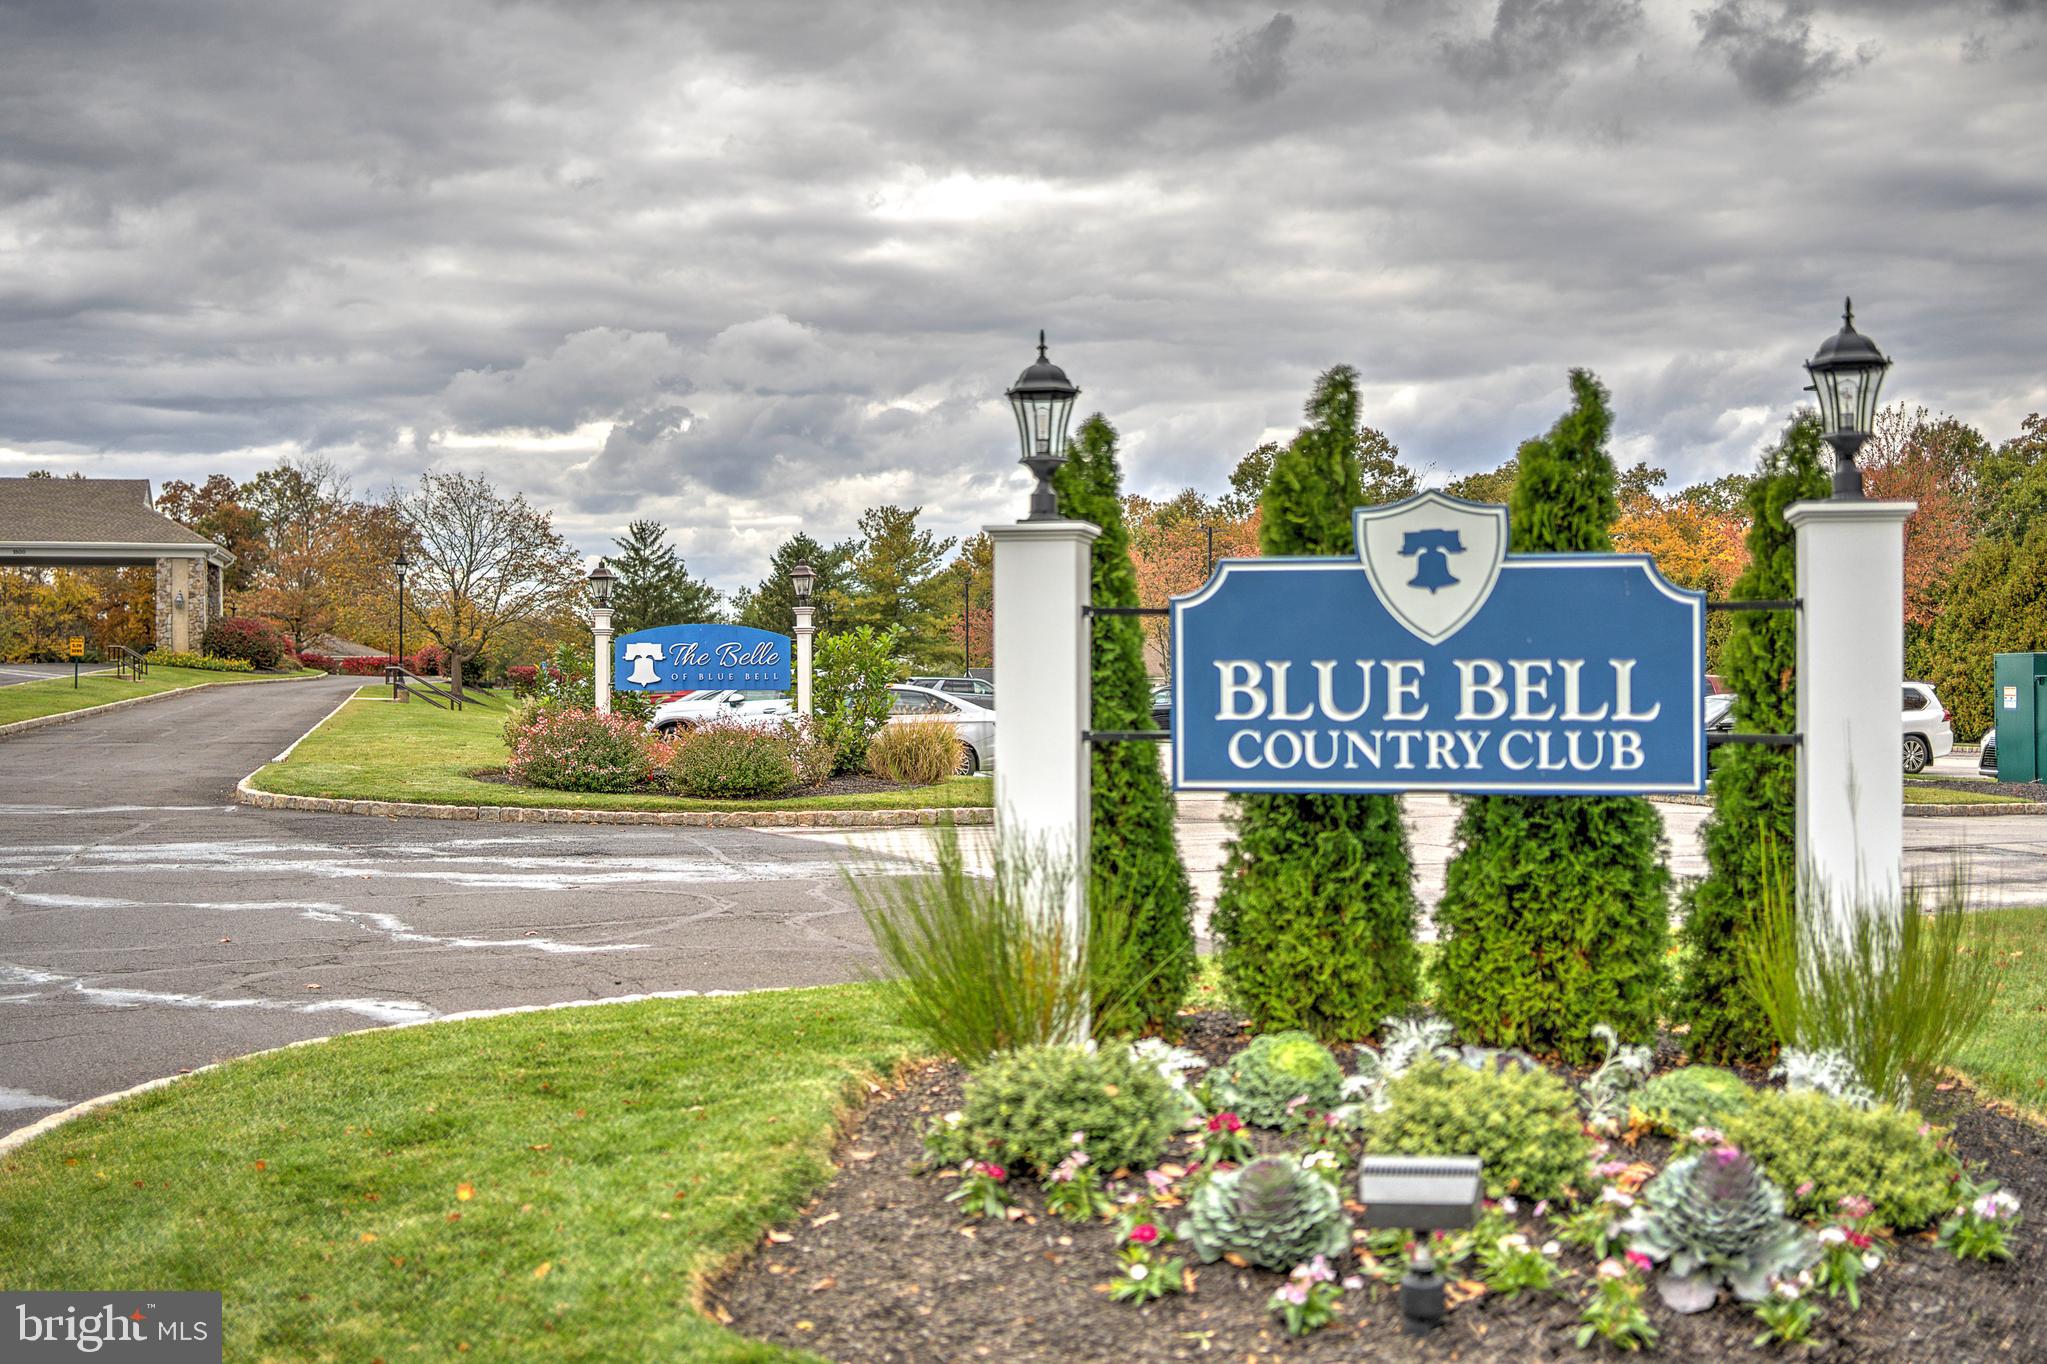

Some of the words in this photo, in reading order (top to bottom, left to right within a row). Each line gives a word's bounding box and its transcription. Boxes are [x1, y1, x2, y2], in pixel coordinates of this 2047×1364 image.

[669, 642, 710, 667] The
[715, 641, 781, 667] Belle
[671, 672, 688, 681] OF
[698, 672, 734, 681] BLUE
[745, 672, 779, 680] BELL
[1213, 659, 1429, 722] BLUE
[1453, 659, 1661, 722] BELL
[1228, 729, 1491, 770] COUNTRY
[1498, 729, 1645, 771] CLUB
